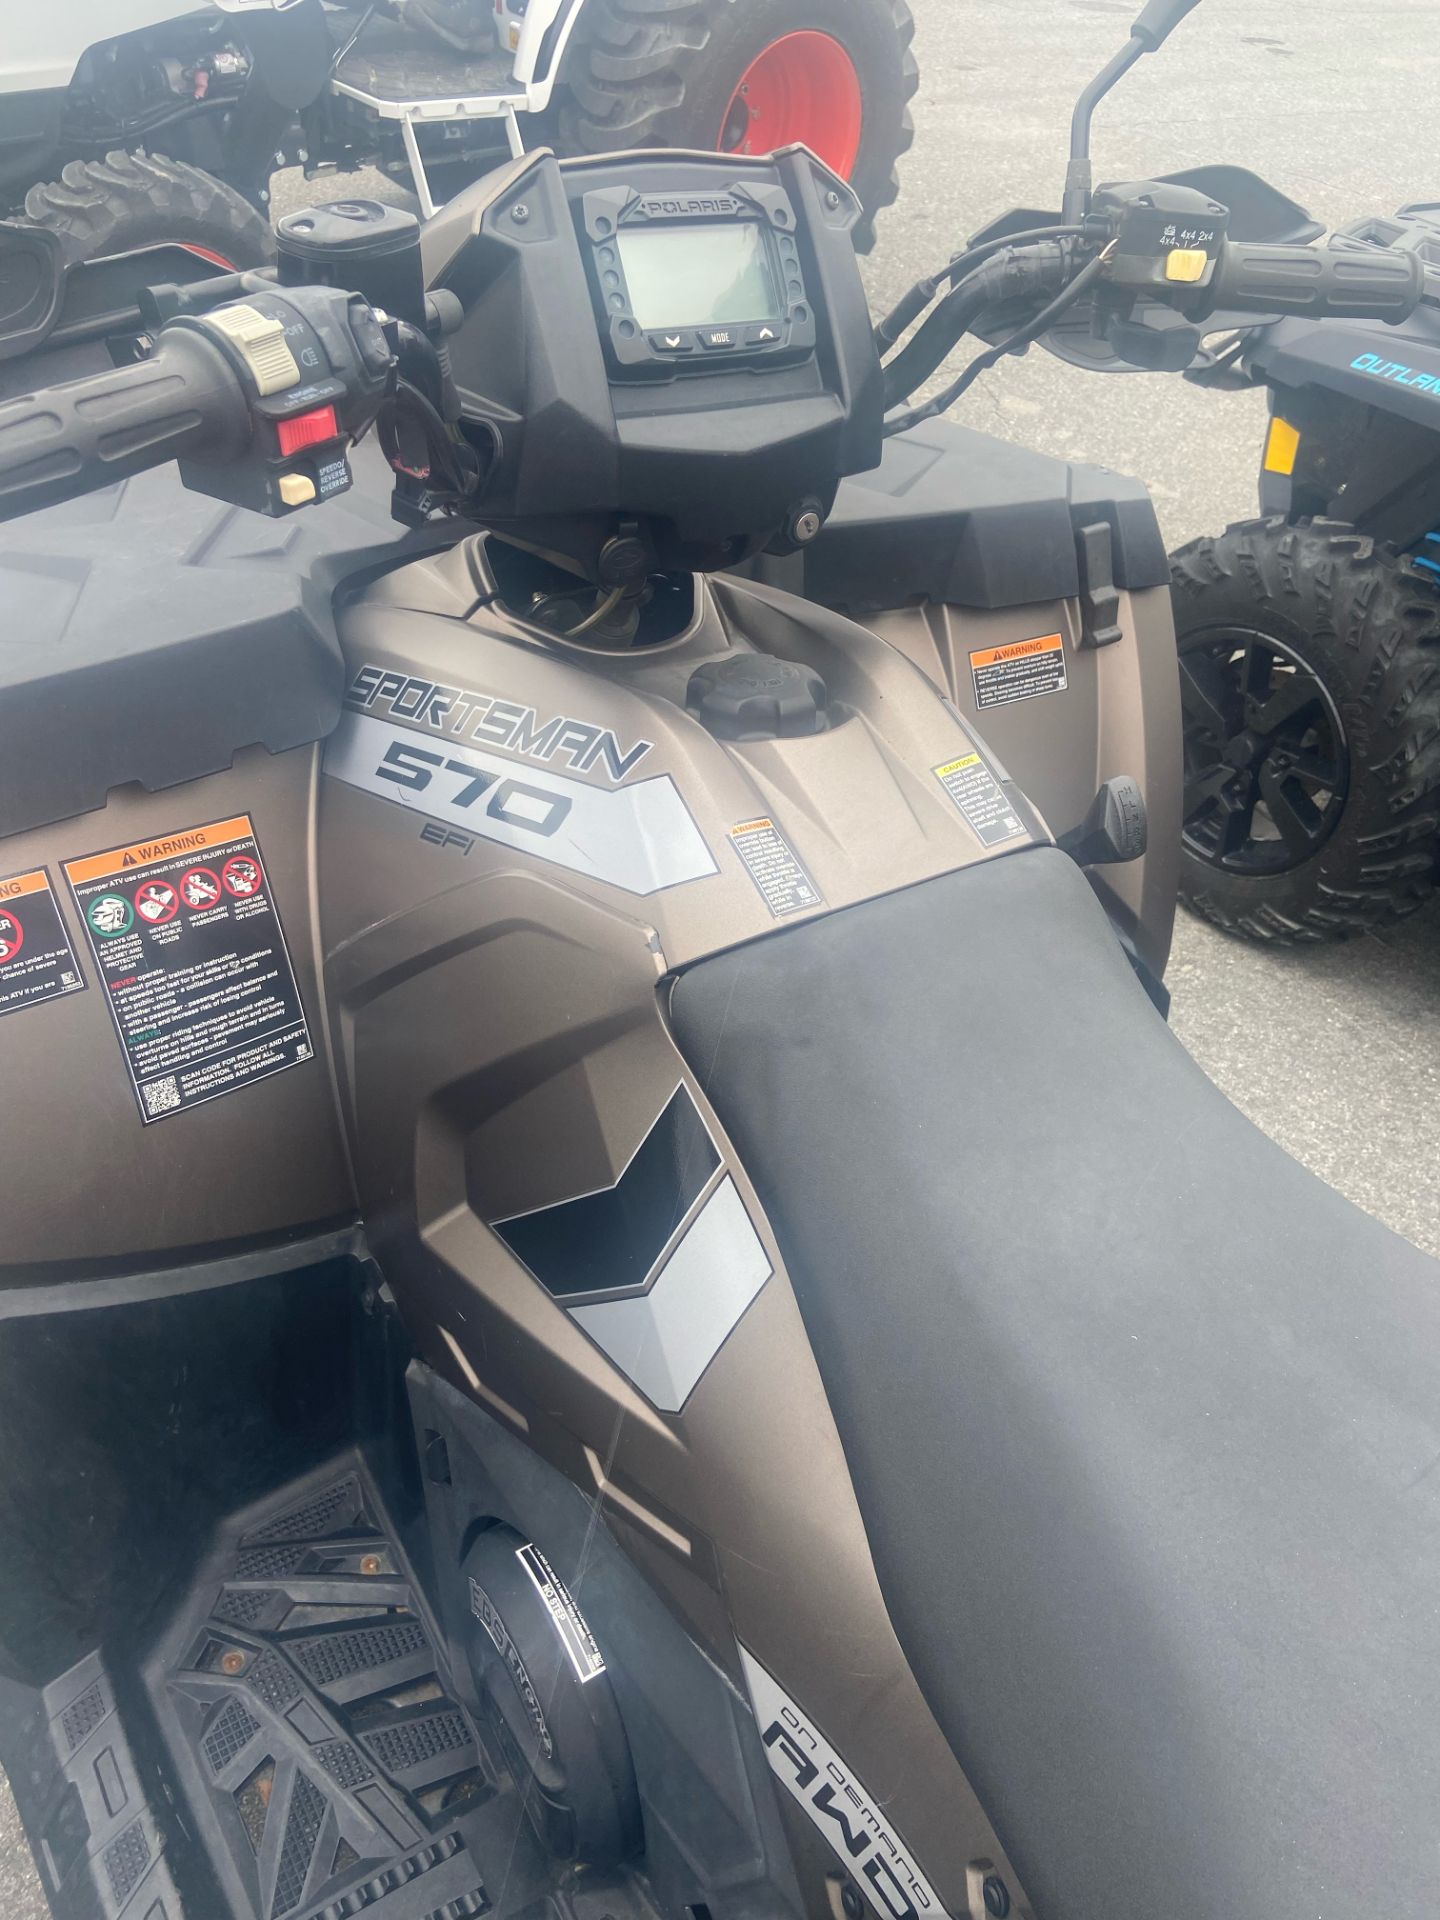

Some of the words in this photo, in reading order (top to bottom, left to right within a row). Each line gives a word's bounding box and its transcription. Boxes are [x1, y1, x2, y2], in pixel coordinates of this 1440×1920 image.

[647, 199, 734, 214] POLARIS
[1160, 235, 1176, 245] 4x4
[1181, 229, 1196, 240] 4x4
[1198, 230, 1213, 241] 2x4
[711, 332, 730, 344] MODE
[320, 459, 345, 476] SPEEDO/
[320, 475, 349, 493] OVERRIDE
[321, 468, 347, 485] REVERSE
[1001, 642, 1042, 658] WARNING
[344, 664, 654, 782] SPORTSMAN
[943, 757, 975, 773] CAUTION
[375, 740, 573, 838] 570
[138, 833, 206, 860] WARNING
[420, 822, 475, 857] EFI
[76, 883, 109, 895] Improper
[109, 877, 123, 886] ATV
[149, 865, 169, 875] result
[174, 855, 202, 868] SEVERE
[202, 849, 225, 860] INJURY
[232, 841, 254, 851] DEATH
[234, 898, 252, 907] NEVER
[234, 906, 248, 914] WITH
[248, 900, 267, 909] DRUGS
[189, 912, 208, 921] NEVER
[208, 905, 227, 915] CARRY
[191, 912, 229, 927] PASSENGERS
[245, 906, 269, 917] ALCOHOL
[148, 924, 169, 934] NEVER
[161, 926, 182, 937] PUBLIC
[99, 937, 126, 949] ALWAYS
[126, 933, 139, 941] USE
[109, 939, 142, 953] APPROVED
[158, 934, 179, 944] ROADS
[25, 956, 44, 965] under
[103, 951, 127, 962] HELMET
[128, 946, 142, 954] AND
[106, 953, 143, 968] PROTECTIVE
[2, 969, 26, 980] chance
[35, 960, 57, 970] severe
[111, 977, 136, 989] NEVER
[137, 968, 165, 981] operate:
[117, 984, 144, 996] without
[144, 976, 167, 988] proper
[168, 968, 194, 979] training
[202, 953, 236, 967] instruction
[128, 990, 153, 1001] speeds
[191, 972, 205, 981] your
[240, 949, 272, 963] conditions
[133, 997, 155, 1009] public
[156, 991, 175, 1000] roads
[185, 978, 213, 990] collision
[226, 967, 245, 976] occur
[245, 961, 259, 969] with
[10, 989, 24, 999] ATV
[127, 1018, 142, 1027] with
[148, 1005, 183, 1021] passenger
[187, 991, 224, 1007] passengers
[242, 976, 266, 986] balance
[267, 970, 278, 978] and
[124, 1007, 151, 1020] another
[152, 999, 176, 1010] vehicle
[129, 1023, 157, 1035] steering
[157, 1016, 170, 1025] and
[171, 1008, 199, 1020] increase
[199, 1002, 212, 1010] risk
[220, 993, 240, 1003] losing
[240, 984, 261, 996] control
[134, 1043, 147, 1051] use
[148, 1034, 171, 1047] proper
[171, 1027, 192, 1037] riding
[192, 1014, 227, 1030] techniques
[235, 1003, 253, 1014] avoid
[253, 996, 275, 1007] vehicle
[136, 1044, 169, 1059] overturns
[195, 1028, 207, 1037] and
[208, 1021, 228, 1032] rough
[228, 1014, 248, 1025] terrain
[249, 1008, 261, 1017] and
[268, 1001, 284, 1010] turns
[127, 1029, 161, 1044] ALWAYS:
[138, 1055, 158, 1067] avoid
[159, 1047, 180, 1060] paved
[180, 1037, 209, 1051] surfaces
[213, 1024, 243, 1040] pavement
[244, 1019, 257, 1027] may
[258, 1009, 286, 1022] seriously
[161, 1053, 190, 1066] handling
[191, 1046, 204, 1055] and
[204, 1037, 227, 1050] control
[180, 1069, 200, 1082] SCAN
[201, 1061, 221, 1074] CODE
[221, 1056, 236, 1066] FOR
[236, 1043, 268, 1060] PRODUCT
[268, 1038, 282, 1048] AND
[282, 1028, 306, 1042] SAFETY
[182, 1067, 231, 1090] INFORMATION.
[233, 1054, 262, 1070] FOLLOW
[261, 1049, 275, 1058] ALL
[184, 1073, 234, 1097] INSTRUCTIONS
[234, 1067, 250, 1077] AND
[250, 1053, 286, 1071] WARNINGS.
[541, 1583, 554, 1598] NO
[762, 1720, 920, 1920] AWD
